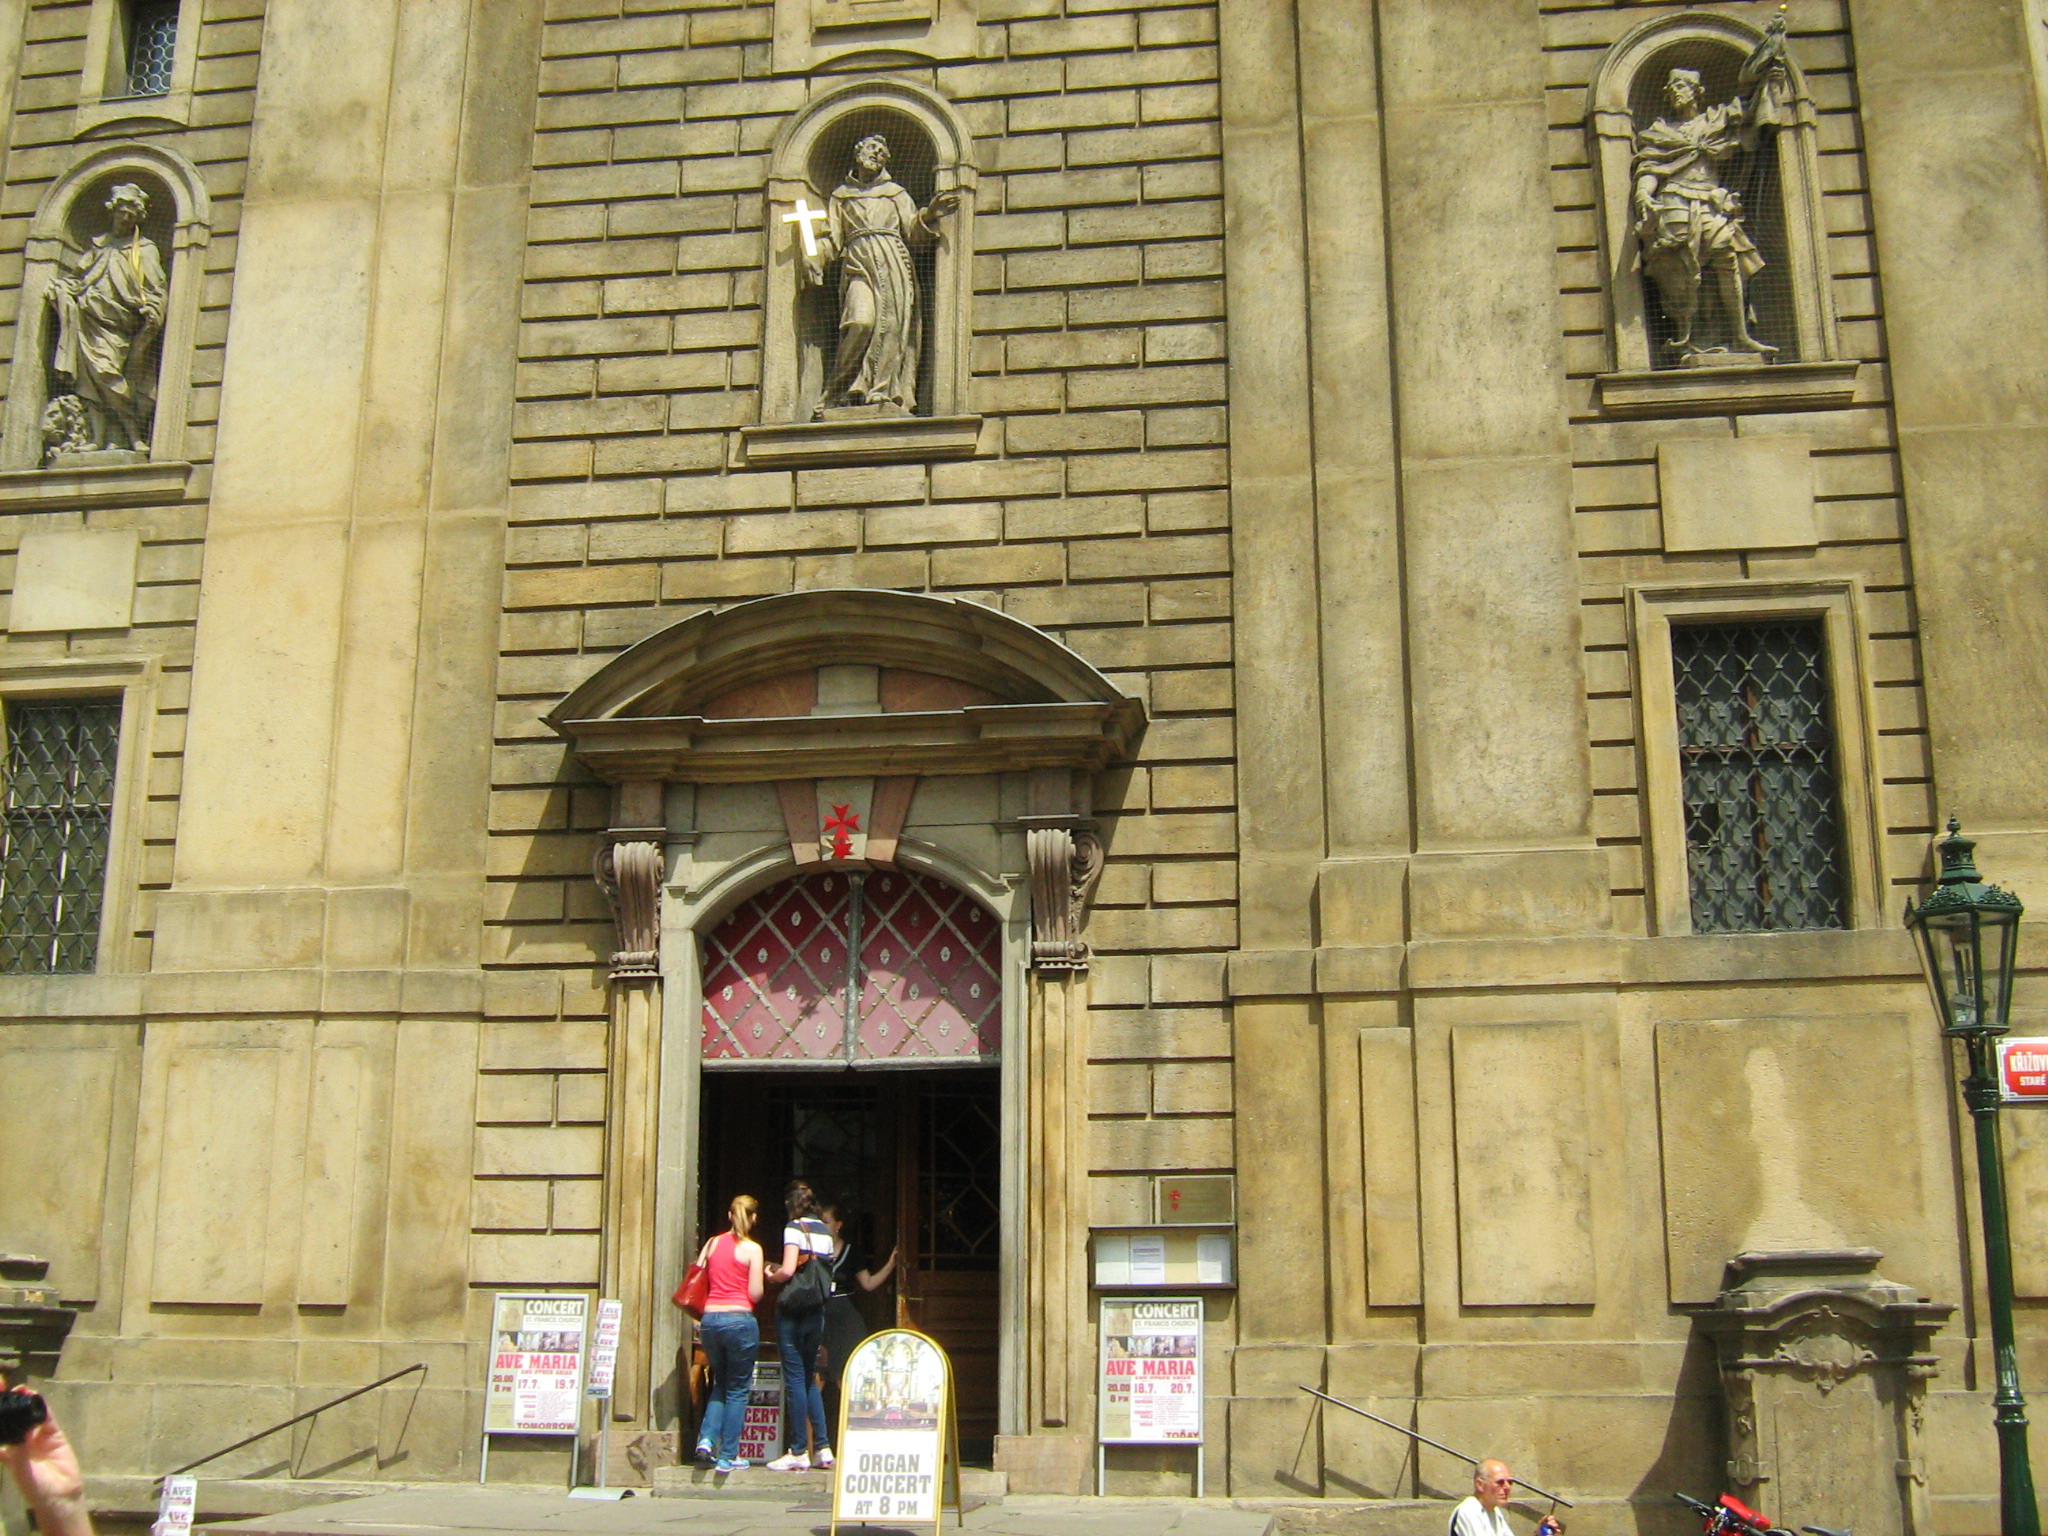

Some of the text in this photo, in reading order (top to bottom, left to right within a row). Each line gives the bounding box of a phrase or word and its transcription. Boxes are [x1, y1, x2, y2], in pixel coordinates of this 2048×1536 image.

[2019, 1073, 2046, 1086] STARÉ
[526, 1300, 584, 1315] CONCERT
[1135, 1304, 1197, 1318] CONCERT
[495, 1354, 577, 1370] AVE MARIA
[1106, 1360, 1195, 1376] AVE MARIA
[492, 1374, 514, 1383] 20.00
[518, 1379, 541, 1389] 17.7.
[554, 1379, 579, 1390] 19.7.
[494, 1384, 500, 1392] 8
[1107, 1383, 1130, 1392] 20.00
[1134, 1383, 1157, 1394] 18.7.
[1170, 1383, 1196, 1394] 20.7.
[1110, 1394, 1116, 1402] 8
[744, 1407, 780, 1423] CERT
[517, 1422, 576, 1430] TOMORROW
[740, 1425, 777, 1441] KETS
[738, 1443, 765, 1458] ERE
[859, 1453, 920, 1473] ORGAN
[845, 1474, 932, 1494] CONCERT
[854, 1495, 918, 1516] AT 8 PM
